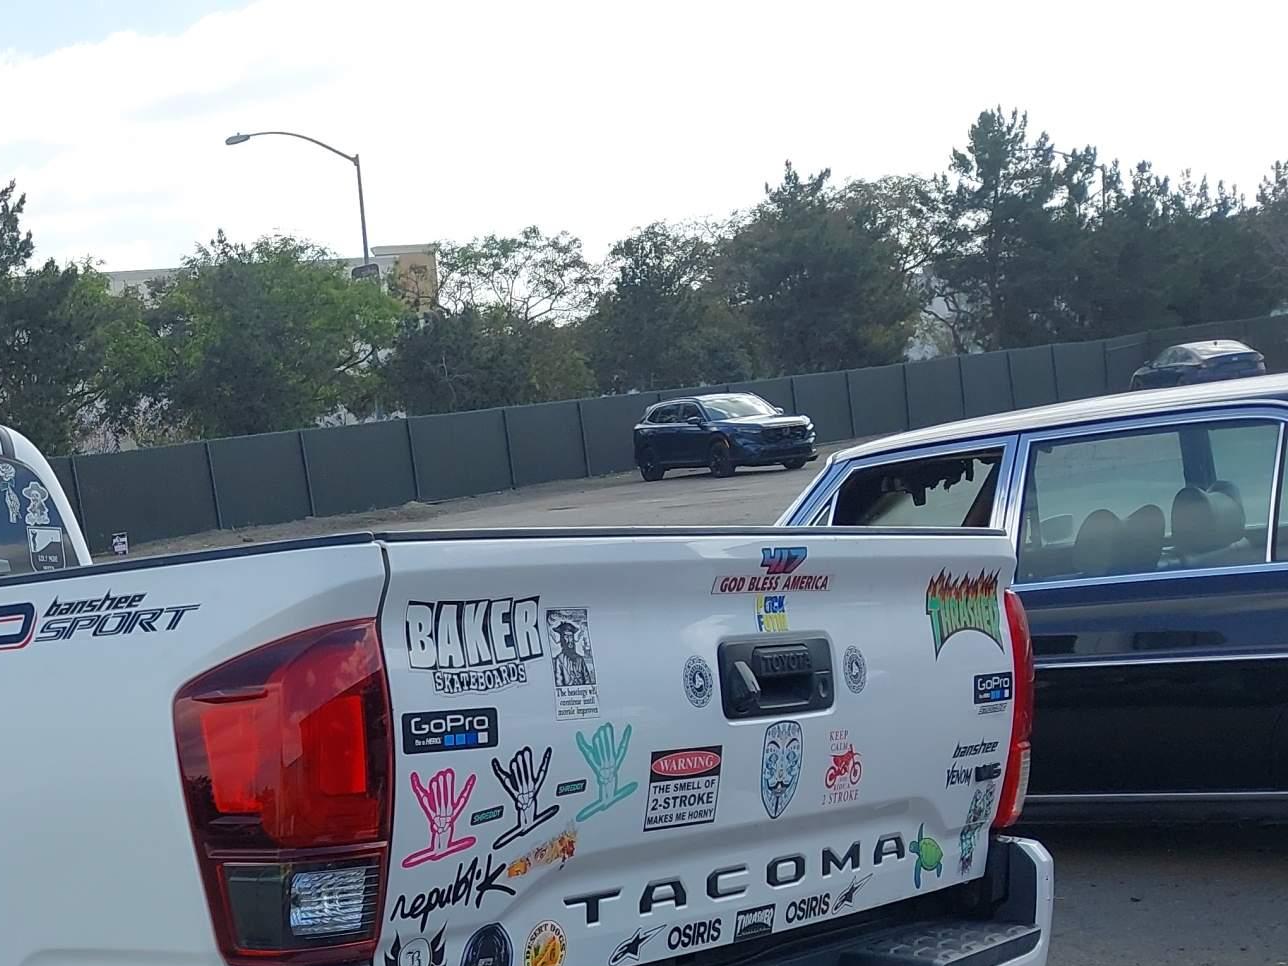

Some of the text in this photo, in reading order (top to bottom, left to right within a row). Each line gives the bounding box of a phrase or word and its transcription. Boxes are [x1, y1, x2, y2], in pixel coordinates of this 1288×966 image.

[720, 575, 829, 592] GOD BLESS AMERICA
[43, 588, 147, 618] banshee
[33, 603, 201, 643] SPORT
[405, 596, 543, 670] BAKER
[433, 662, 527, 693] SKATEBOARDS
[977, 676, 1010, 691] GoPro
[556, 687, 567, 697] The
[411, 714, 489, 735] GoPro
[830, 729, 848, 741] KEEP
[952, 737, 1000, 759] banshee
[659, 755, 714, 771] WARNING
[945, 761, 974, 790] VENOM
[653, 779, 716, 794] THE SMELL OF
[651, 792, 714, 812] 2-STROKE
[829, 789, 859, 805] STROKE
[473, 809, 502, 823] SHREDDY
[647, 808, 713, 825] MAKES ME HORNY
[562, 831, 907, 926] TACOMA
[785, 892, 831, 925] OSIRIS
[667, 918, 723, 951] OSIRIS
